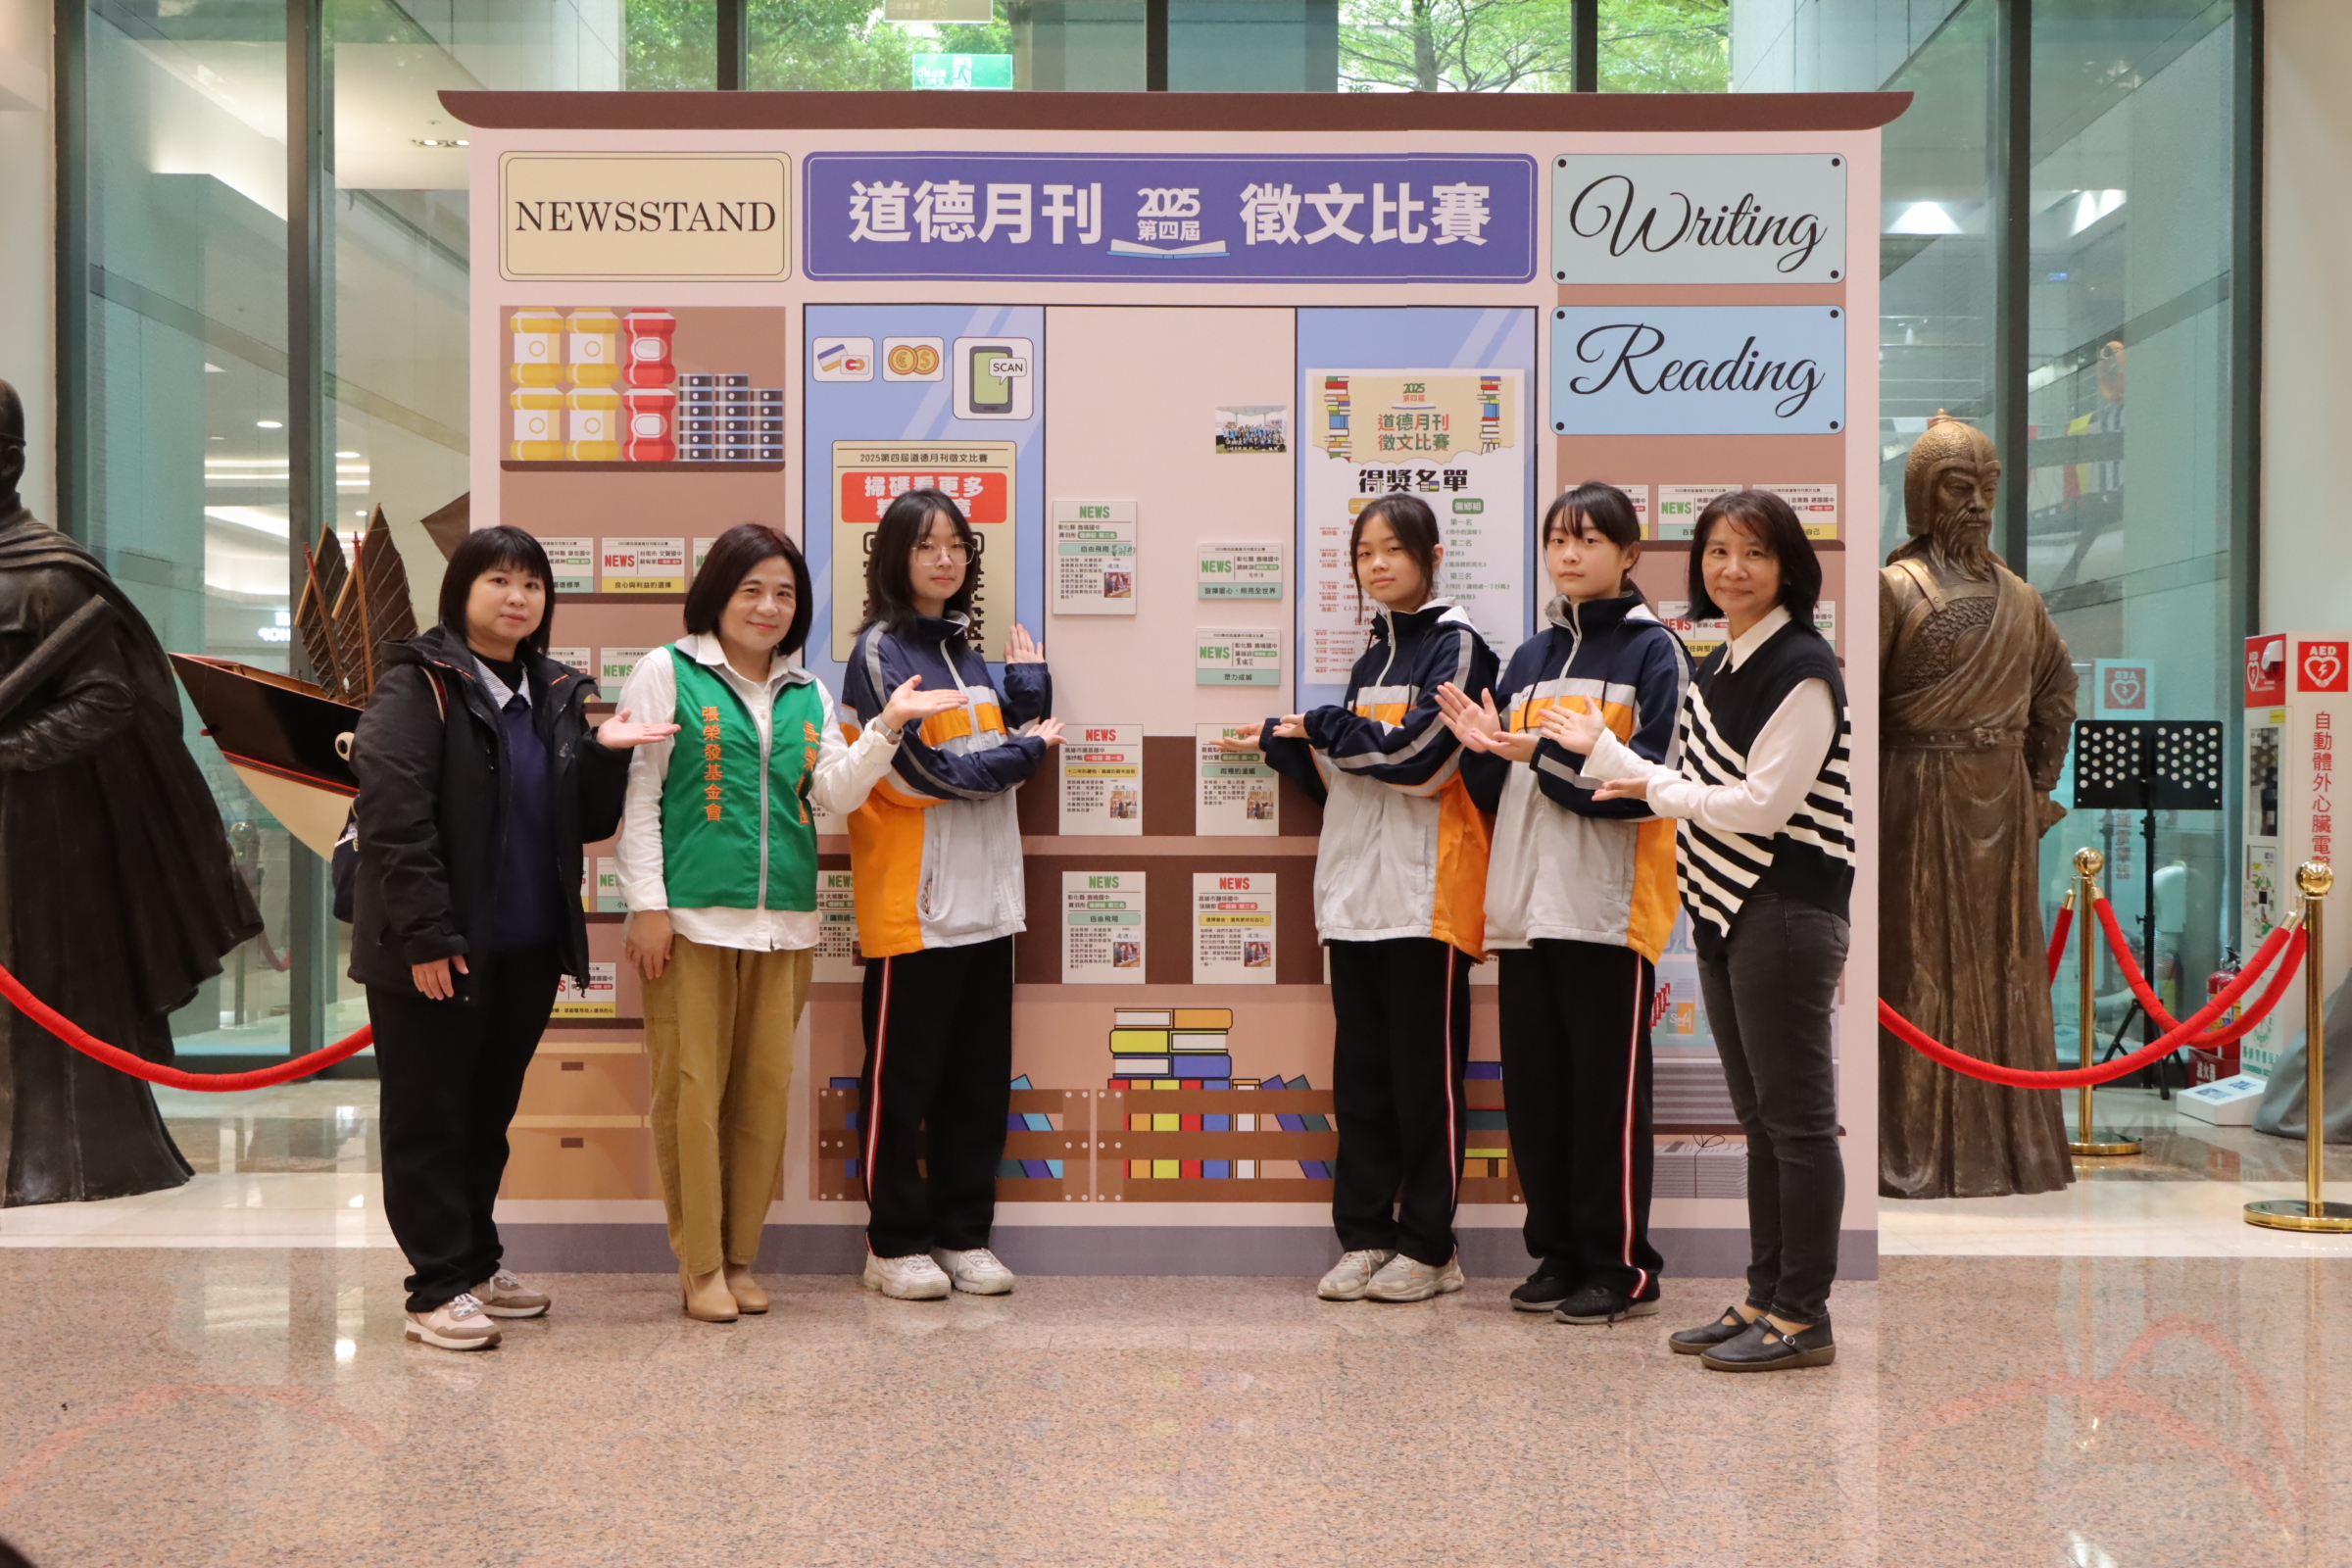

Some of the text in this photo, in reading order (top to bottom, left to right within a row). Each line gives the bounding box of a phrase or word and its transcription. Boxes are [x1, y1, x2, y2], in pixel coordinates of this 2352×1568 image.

[1136, 187, 1200, 218] 2025
[514, 201, 776, 231] NEWSSTAND
[849, 179, 1102, 245] 道德月刊
[1239, 181, 1492, 246] 徵文比賽
[1569, 174, 1828, 273] Writing
[1136, 220, 1200, 242] 第四屆
[993, 363, 1023, 372] SCAN
[1569, 322, 1826, 418] Reading
[1402, 383, 1425, 394] 2025
[1402, 394, 1425, 403] 第四屆
[1378, 414, 1449, 431] 道德月刊
[1378, 433, 1449, 452] 徵文比賽
[859, 453, 988, 464] 2025第四屆道德月刊徵文比賽
[1359, 468, 1468, 494] 得獎名單
[1079, 506, 1110, 518] NEWS
[1661, 502, 1692, 514] NEWS
[605, 555, 635, 567] NEWS
[1201, 561, 1232, 573] NEWS
[1200, 646, 1230, 660] NEWS
[2309, 646, 2337, 656] AED
[1086, 729, 1116, 742] NEWS
[701, 706, 723, 821] 張榮發基金會
[828, 874, 855, 888] NEW
[1089, 875, 1119, 889] NEWS
[1219, 877, 1250, 890] NEWS
